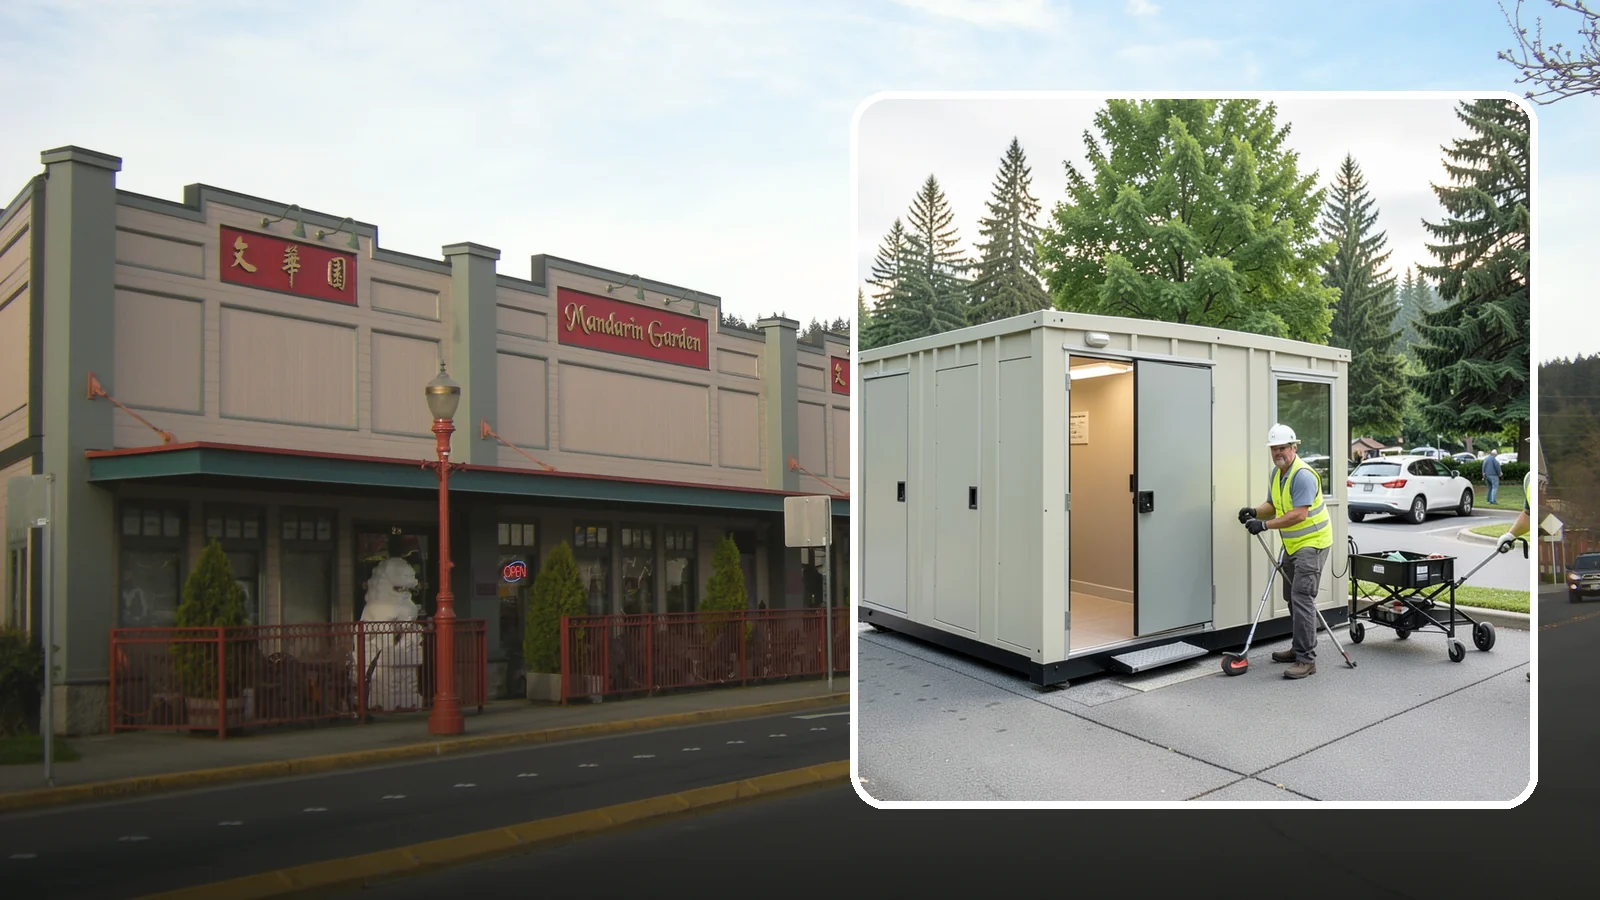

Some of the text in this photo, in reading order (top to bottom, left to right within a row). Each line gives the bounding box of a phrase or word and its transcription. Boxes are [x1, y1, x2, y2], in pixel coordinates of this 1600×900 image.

[564, 302, 701, 352] Mandarin Garden
[503, 565, 527, 578] OPEN
